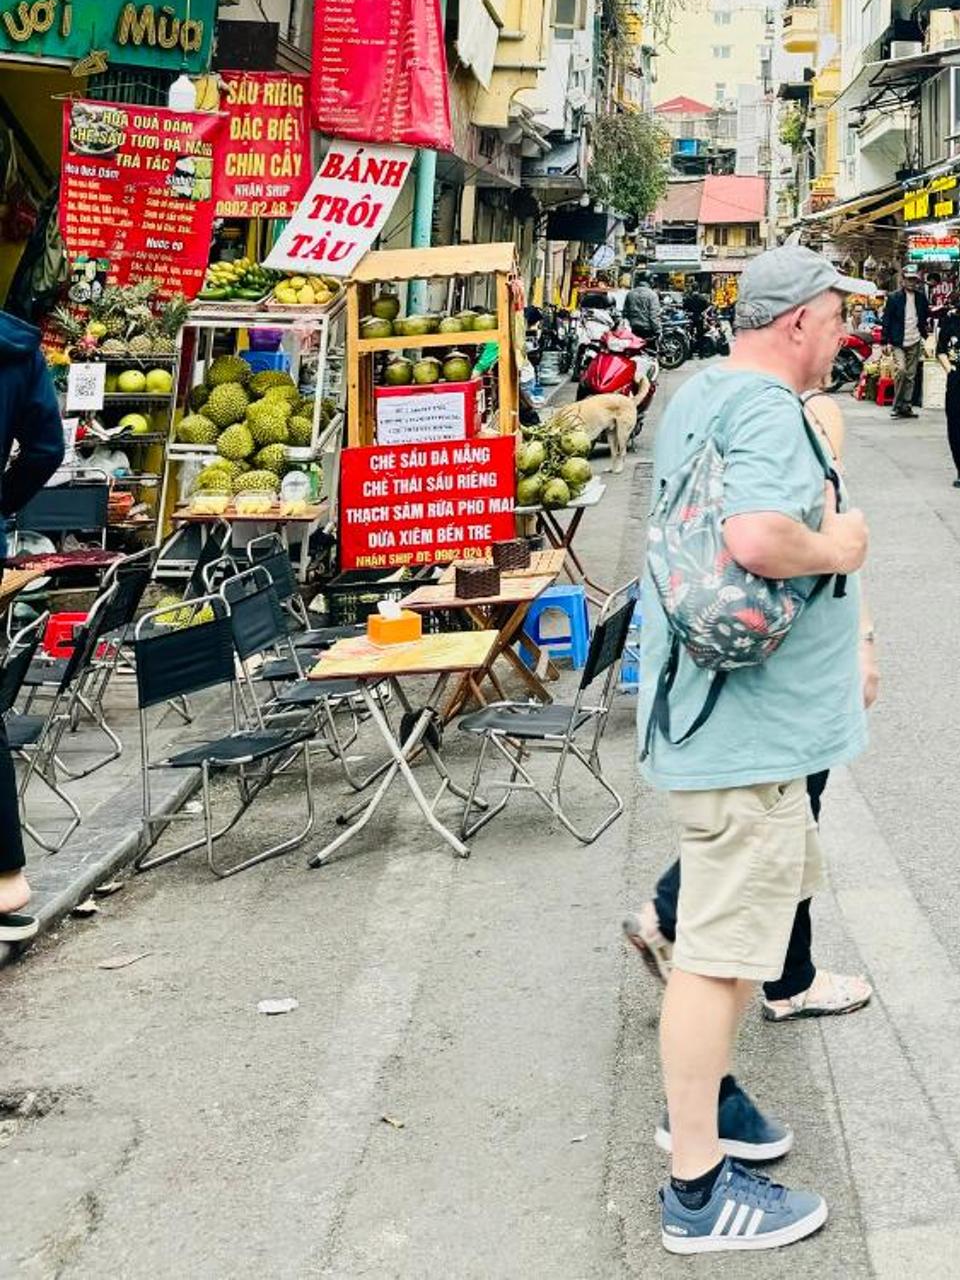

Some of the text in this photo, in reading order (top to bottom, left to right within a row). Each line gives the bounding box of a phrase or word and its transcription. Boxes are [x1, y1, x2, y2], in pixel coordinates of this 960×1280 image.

[230, 112, 263, 145] ĐẶC
[225, 147, 303, 178] CHÍN CÂY
[319, 148, 408, 187] BÁNH
[266, 183, 291, 197] SHIP
[308, 194, 383, 228] TRÔI
[370, 453, 396, 471] CHÈ
[363, 478, 390, 497] CHÈ
[393, 476, 422, 495] THÁI
[346, 505, 389, 527] THẠCH
[489, 496, 514, 513] MAI
[400, 526, 433, 545] XIÊM
[437, 522, 464, 544] BẾN
[468, 523, 493, 540] TRE
[389, 551, 414, 566] SHIP
